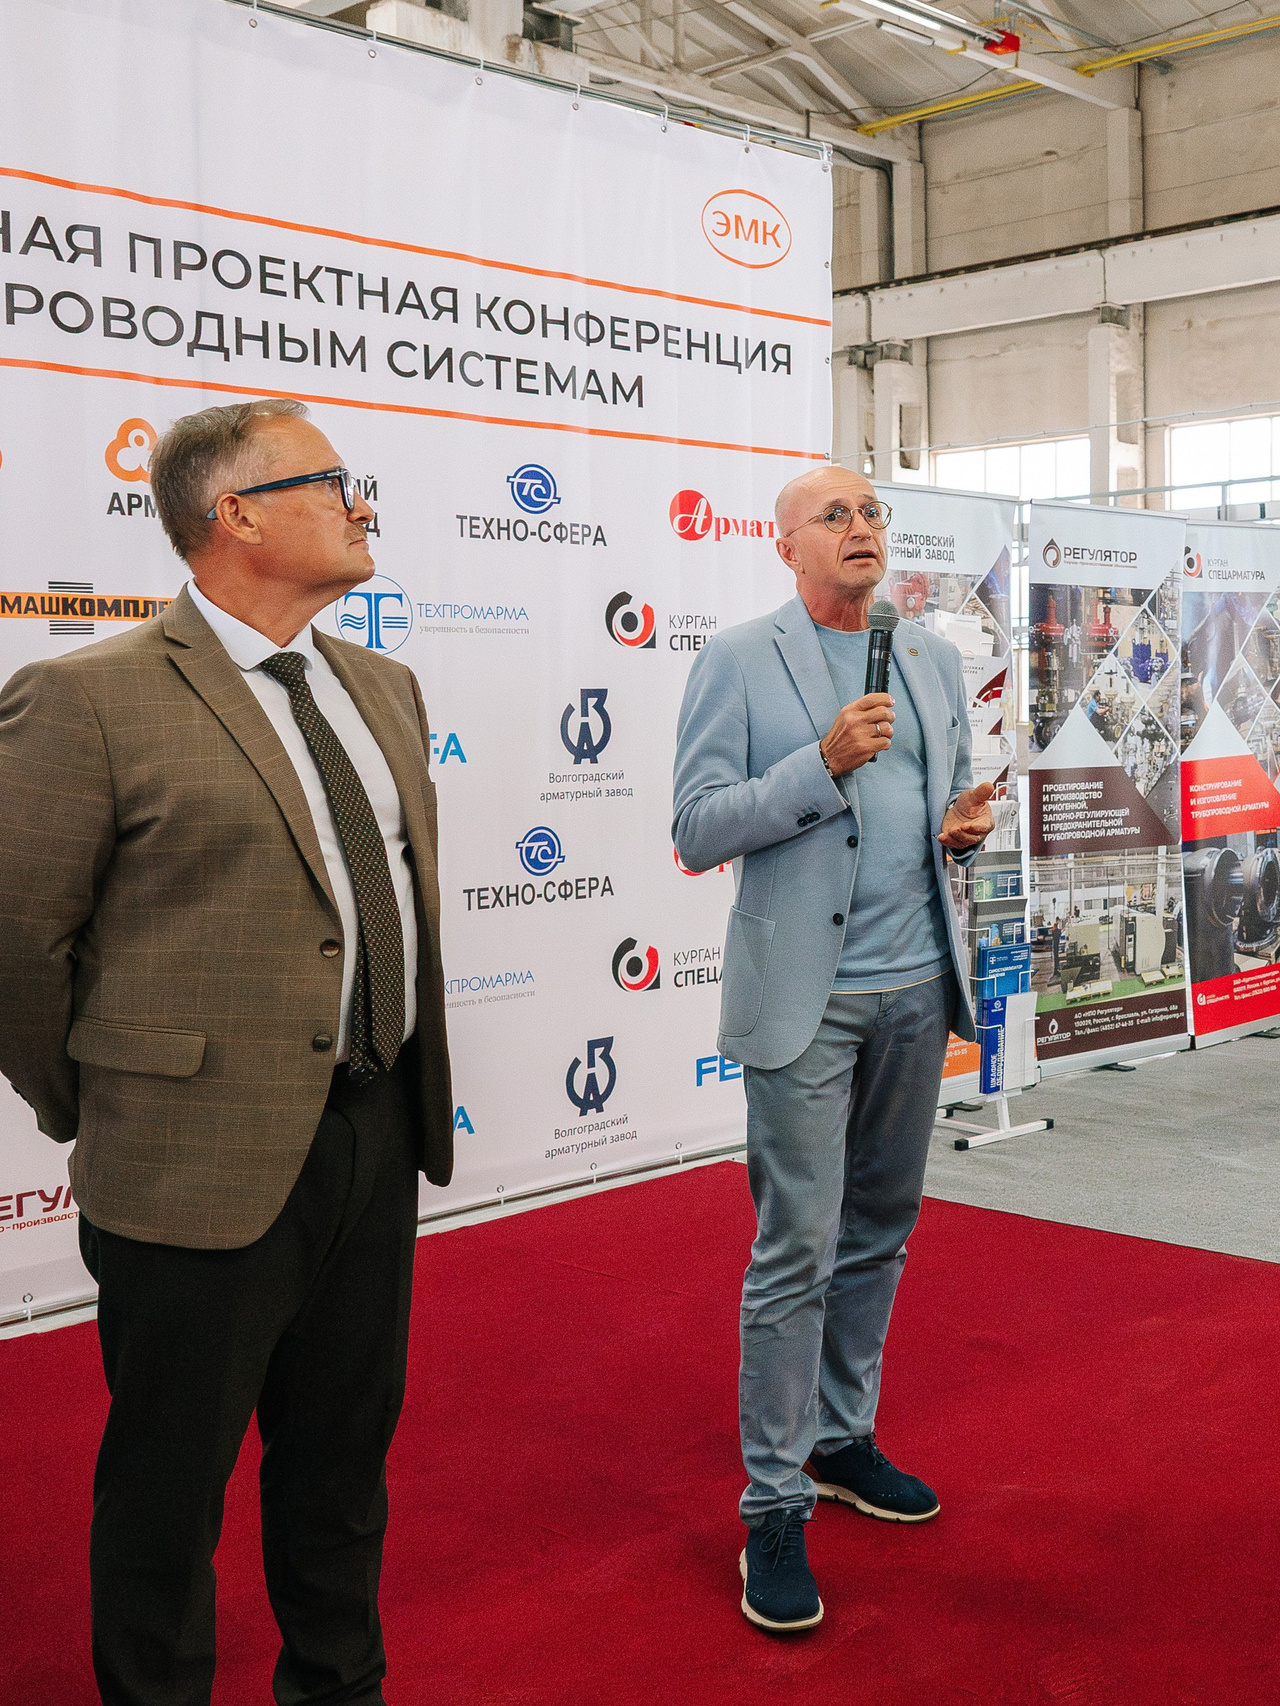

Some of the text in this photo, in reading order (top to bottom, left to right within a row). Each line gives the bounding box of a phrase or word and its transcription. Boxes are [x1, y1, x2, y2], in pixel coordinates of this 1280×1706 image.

[711, 210, 782, 249] ЭМК
[128, 231, 459, 324] ПРОЕКТНАЯ
[475, 292, 792, 376] КОНФЕРЕНЦИЯ
[4, 282, 644, 408] РОВОДНЫМ СИСТЕМАМ
[456, 514, 608, 547] ТЕХНО-СФЕРА
[890, 532, 955, 548] САРАТОВСКИЙ
[888, 545, 956, 563] УРНЫЙ ЗАВОД
[1063, 546, 1138, 564] РЕГУЛЯТОР
[1208, 569, 1266, 581] СПЕЦАРМАТУРА
[0, 595, 172, 619] МАШКОМПЛЕ
[417, 603, 530, 621] ТЕХПРОМАРМА
[669, 614, 717, 630] КУРГАН
[548, 769, 625, 785] Волгоградский
[1042, 781, 1104, 792] ПРОЕКТИРОВАНИЕ
[1189, 779, 1243, 793] КОНСТРУИРОВАНИЕ
[540, 788, 634, 803] арматурный завод
[1042, 790, 1102, 802] И ПРОИЗВОДСТВО
[1190, 793, 1237, 806] И ИЗГОТОВЛЕНИЕ
[1042, 800, 1088, 812] КРИОГЕННОЙ,
[1190, 801, 1270, 819] ТРУБОПРОВОДНОЙ АРМАТУРЫ
[1042, 807, 1130, 822] ЗАПОРНО-РЕГУЛИРУЮЩЕЙ
[1042, 818, 1123, 831] И ПРЕДОХРАНИТЕЛЬНОЙ
[1042, 826, 1140, 842] ТРУБОПРОВОДНОЙ АРМАТУРЫ
[462, 875, 615, 911] ТЕХНО-СФЕРА
[673, 946, 721, 966] КУРГАН
[1036, 1031, 1072, 1045] РЕГУЛЯТОР
[554, 1113, 629, 1140] Волгоградский
[544, 1130, 637, 1159] арматурный завод
